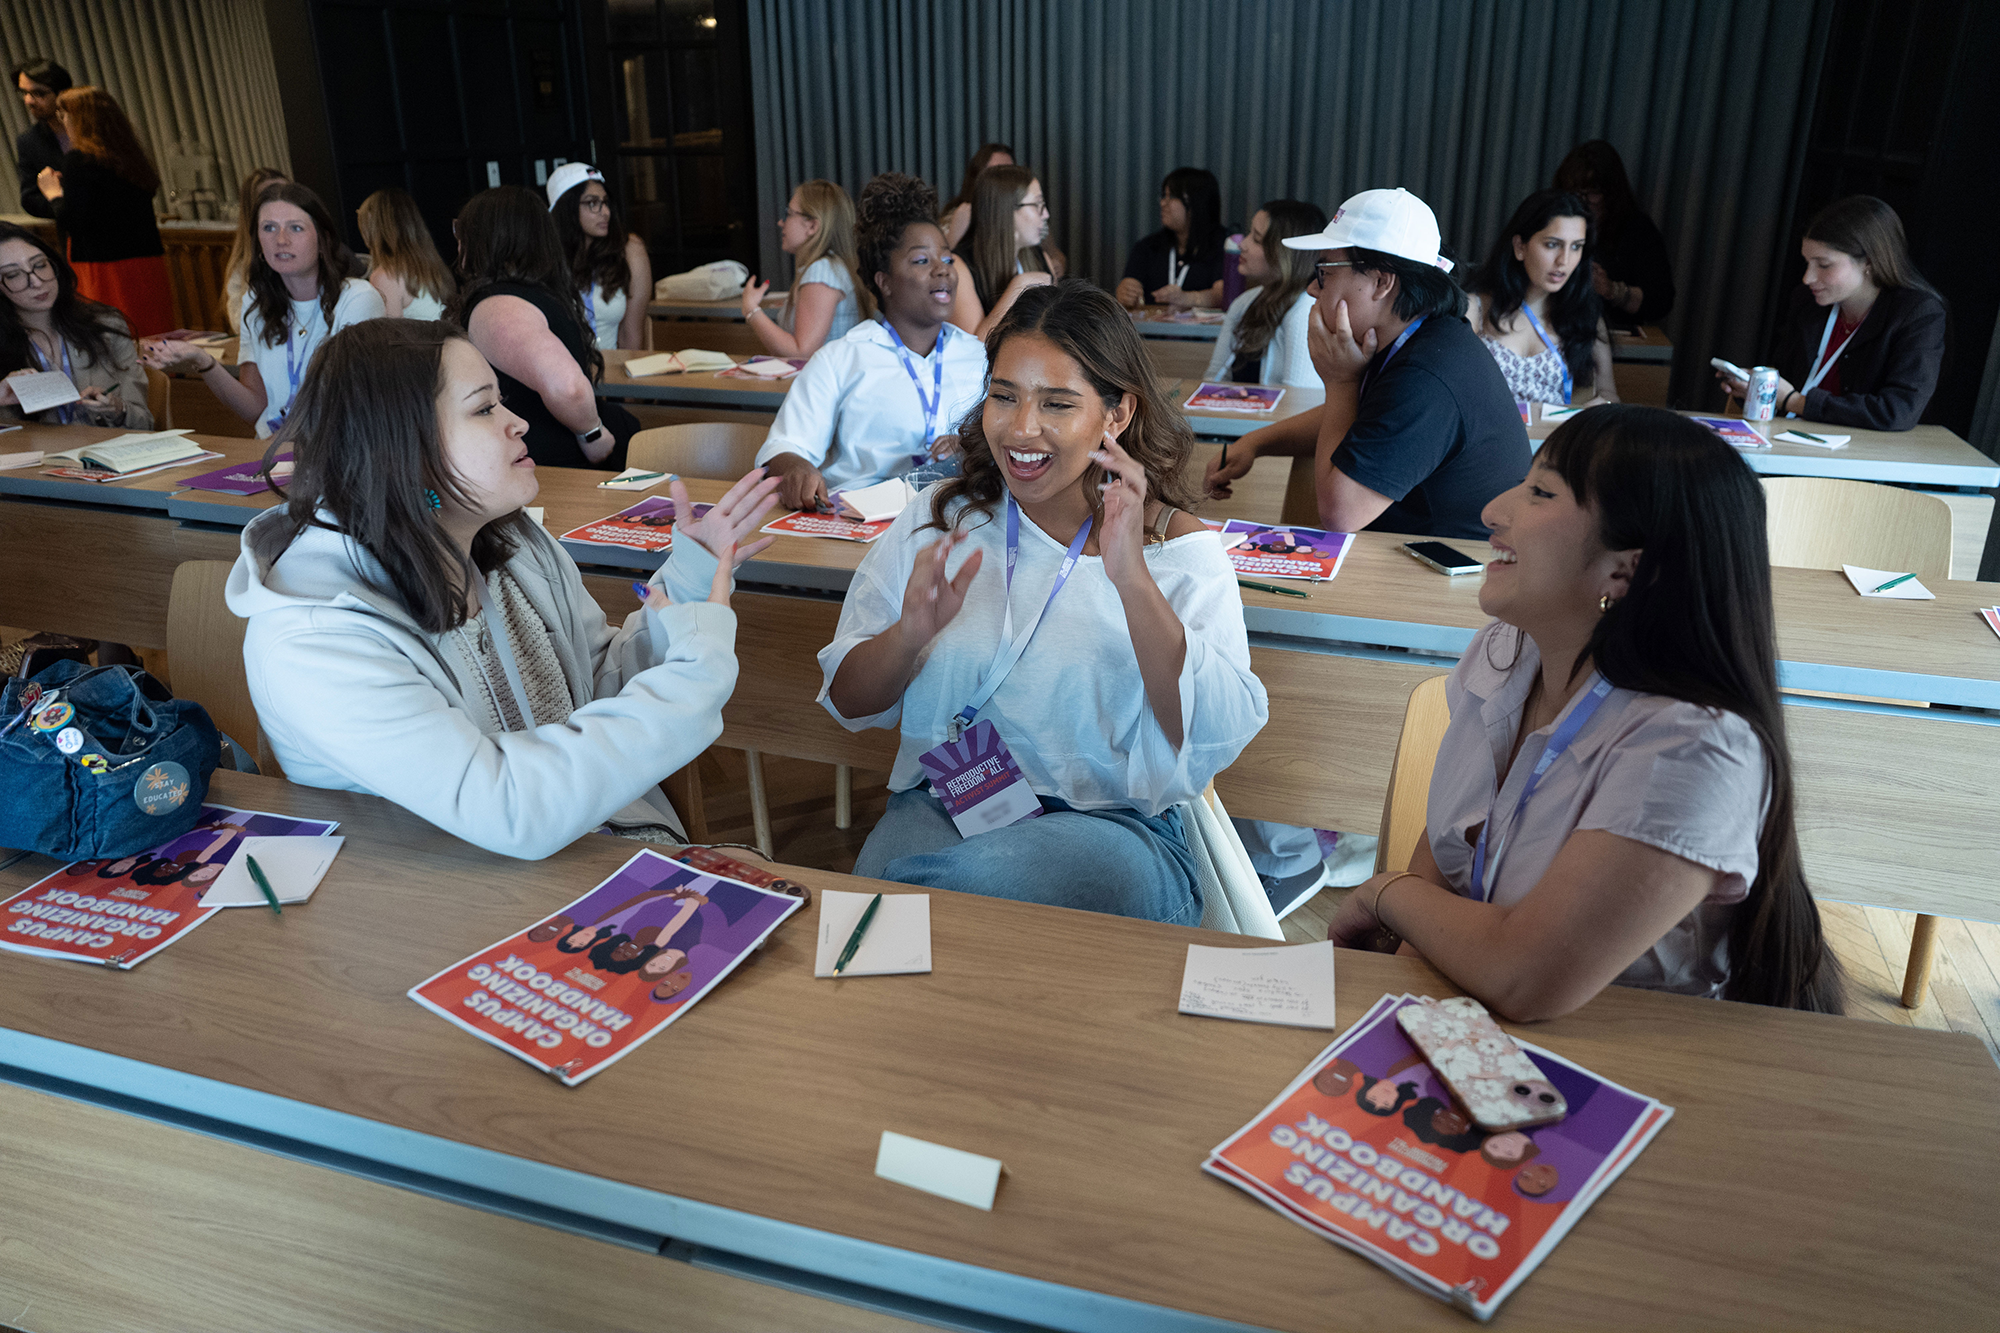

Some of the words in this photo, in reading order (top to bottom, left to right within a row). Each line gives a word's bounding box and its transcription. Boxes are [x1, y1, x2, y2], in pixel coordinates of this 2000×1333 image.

[585, 527, 669, 543] ORGANIZING
[589, 533, 647, 545] CAMPUS
[597, 524, 672, 539] HANDBOOK
[1232, 559, 1323, 572] ORGANIZI
[154, 778, 175, 789] STAY
[946, 755, 1000, 790] REPRODUCTIVE
[950, 772, 986, 798] FREEDOM
[990, 763, 1005, 776] ALL
[955, 785, 984, 807] ACTIVIST
[984, 770, 1011, 791] SUMMIT
[143, 789, 183, 804] EDUCATED
[8, 900, 162, 939] ORGANIZING
[36, 888, 180, 925] HANDBOOK
[7, 918, 114, 948] CAMPUS
[467, 963, 612, 1048] ORGANIZING
[495, 953, 633, 1031] HANDBOOK
[463, 990, 563, 1048] CAMPUS
[1296, 1111, 1511, 1236] HANDBOOK
[1269, 1124, 1500, 1260] ORGANIZING
[1284, 1160, 1440, 1256] CAMPUS
